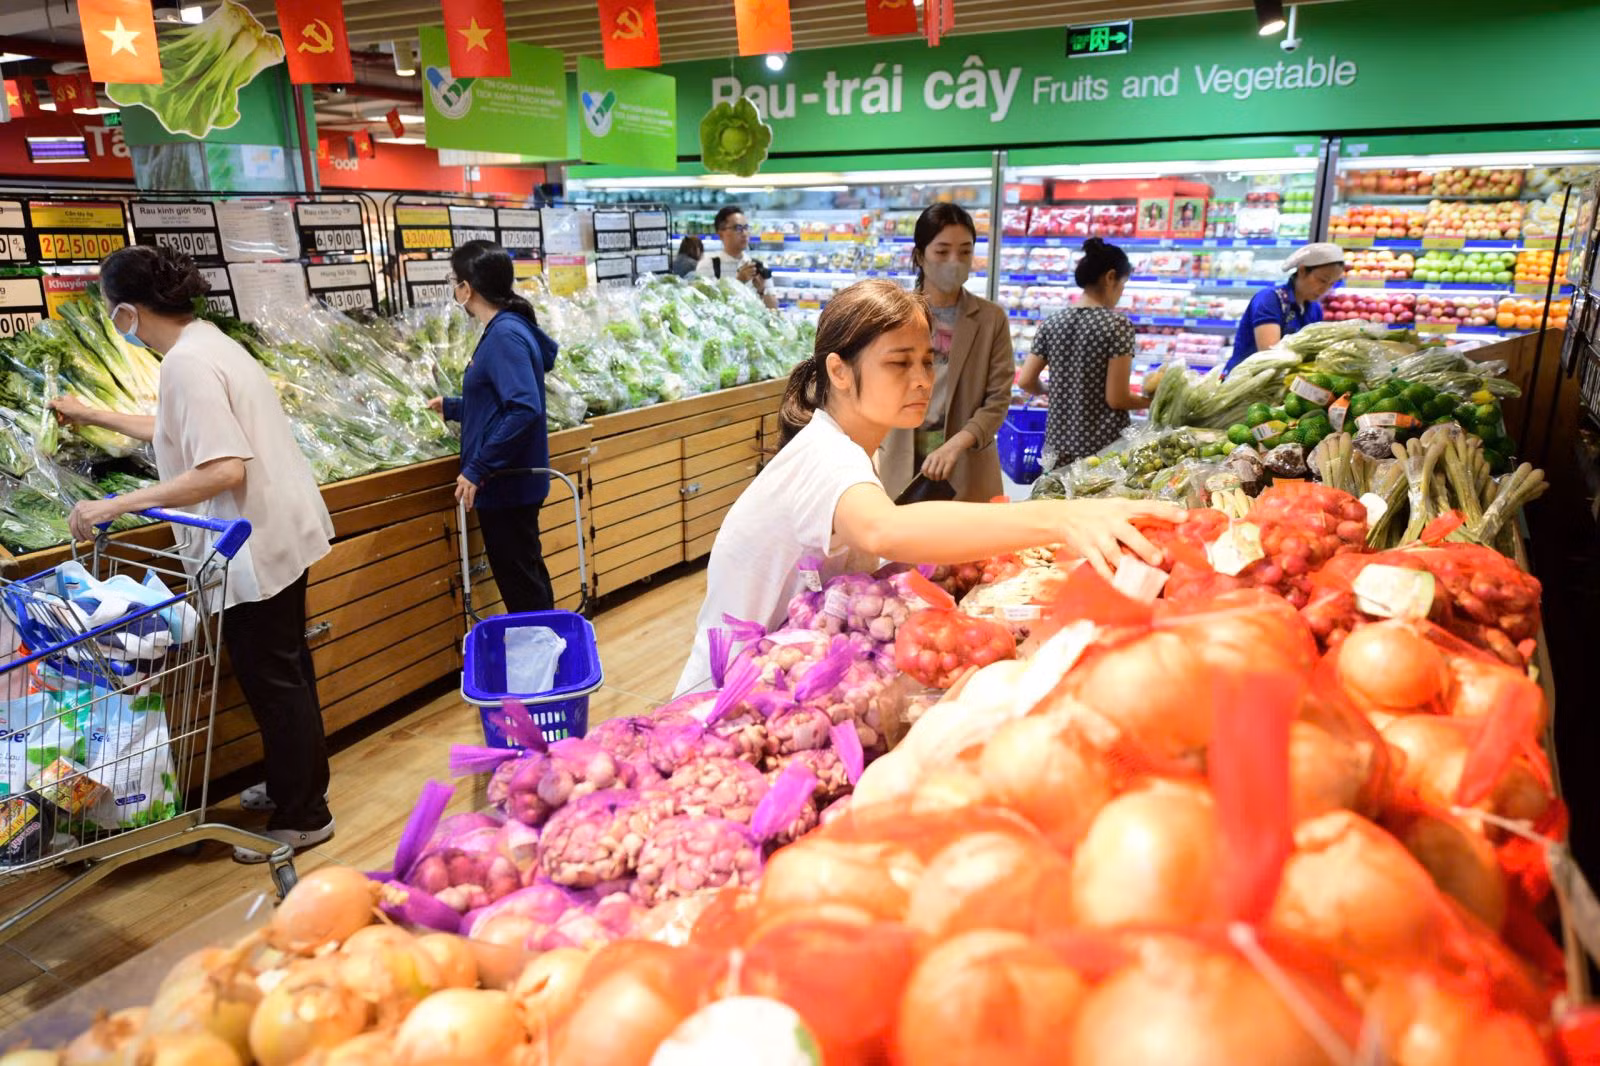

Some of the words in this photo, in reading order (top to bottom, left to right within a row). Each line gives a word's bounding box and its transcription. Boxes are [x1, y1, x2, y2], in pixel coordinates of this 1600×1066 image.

[923, 55, 1022, 122] cây
[1033, 77, 1109, 104] Fruits
[1121, 67, 1180, 99] and
[1195, 55, 1358, 100] Vegetable
[139, 207, 156, 215] Rau
[42, 237, 111, 254] 22.500
